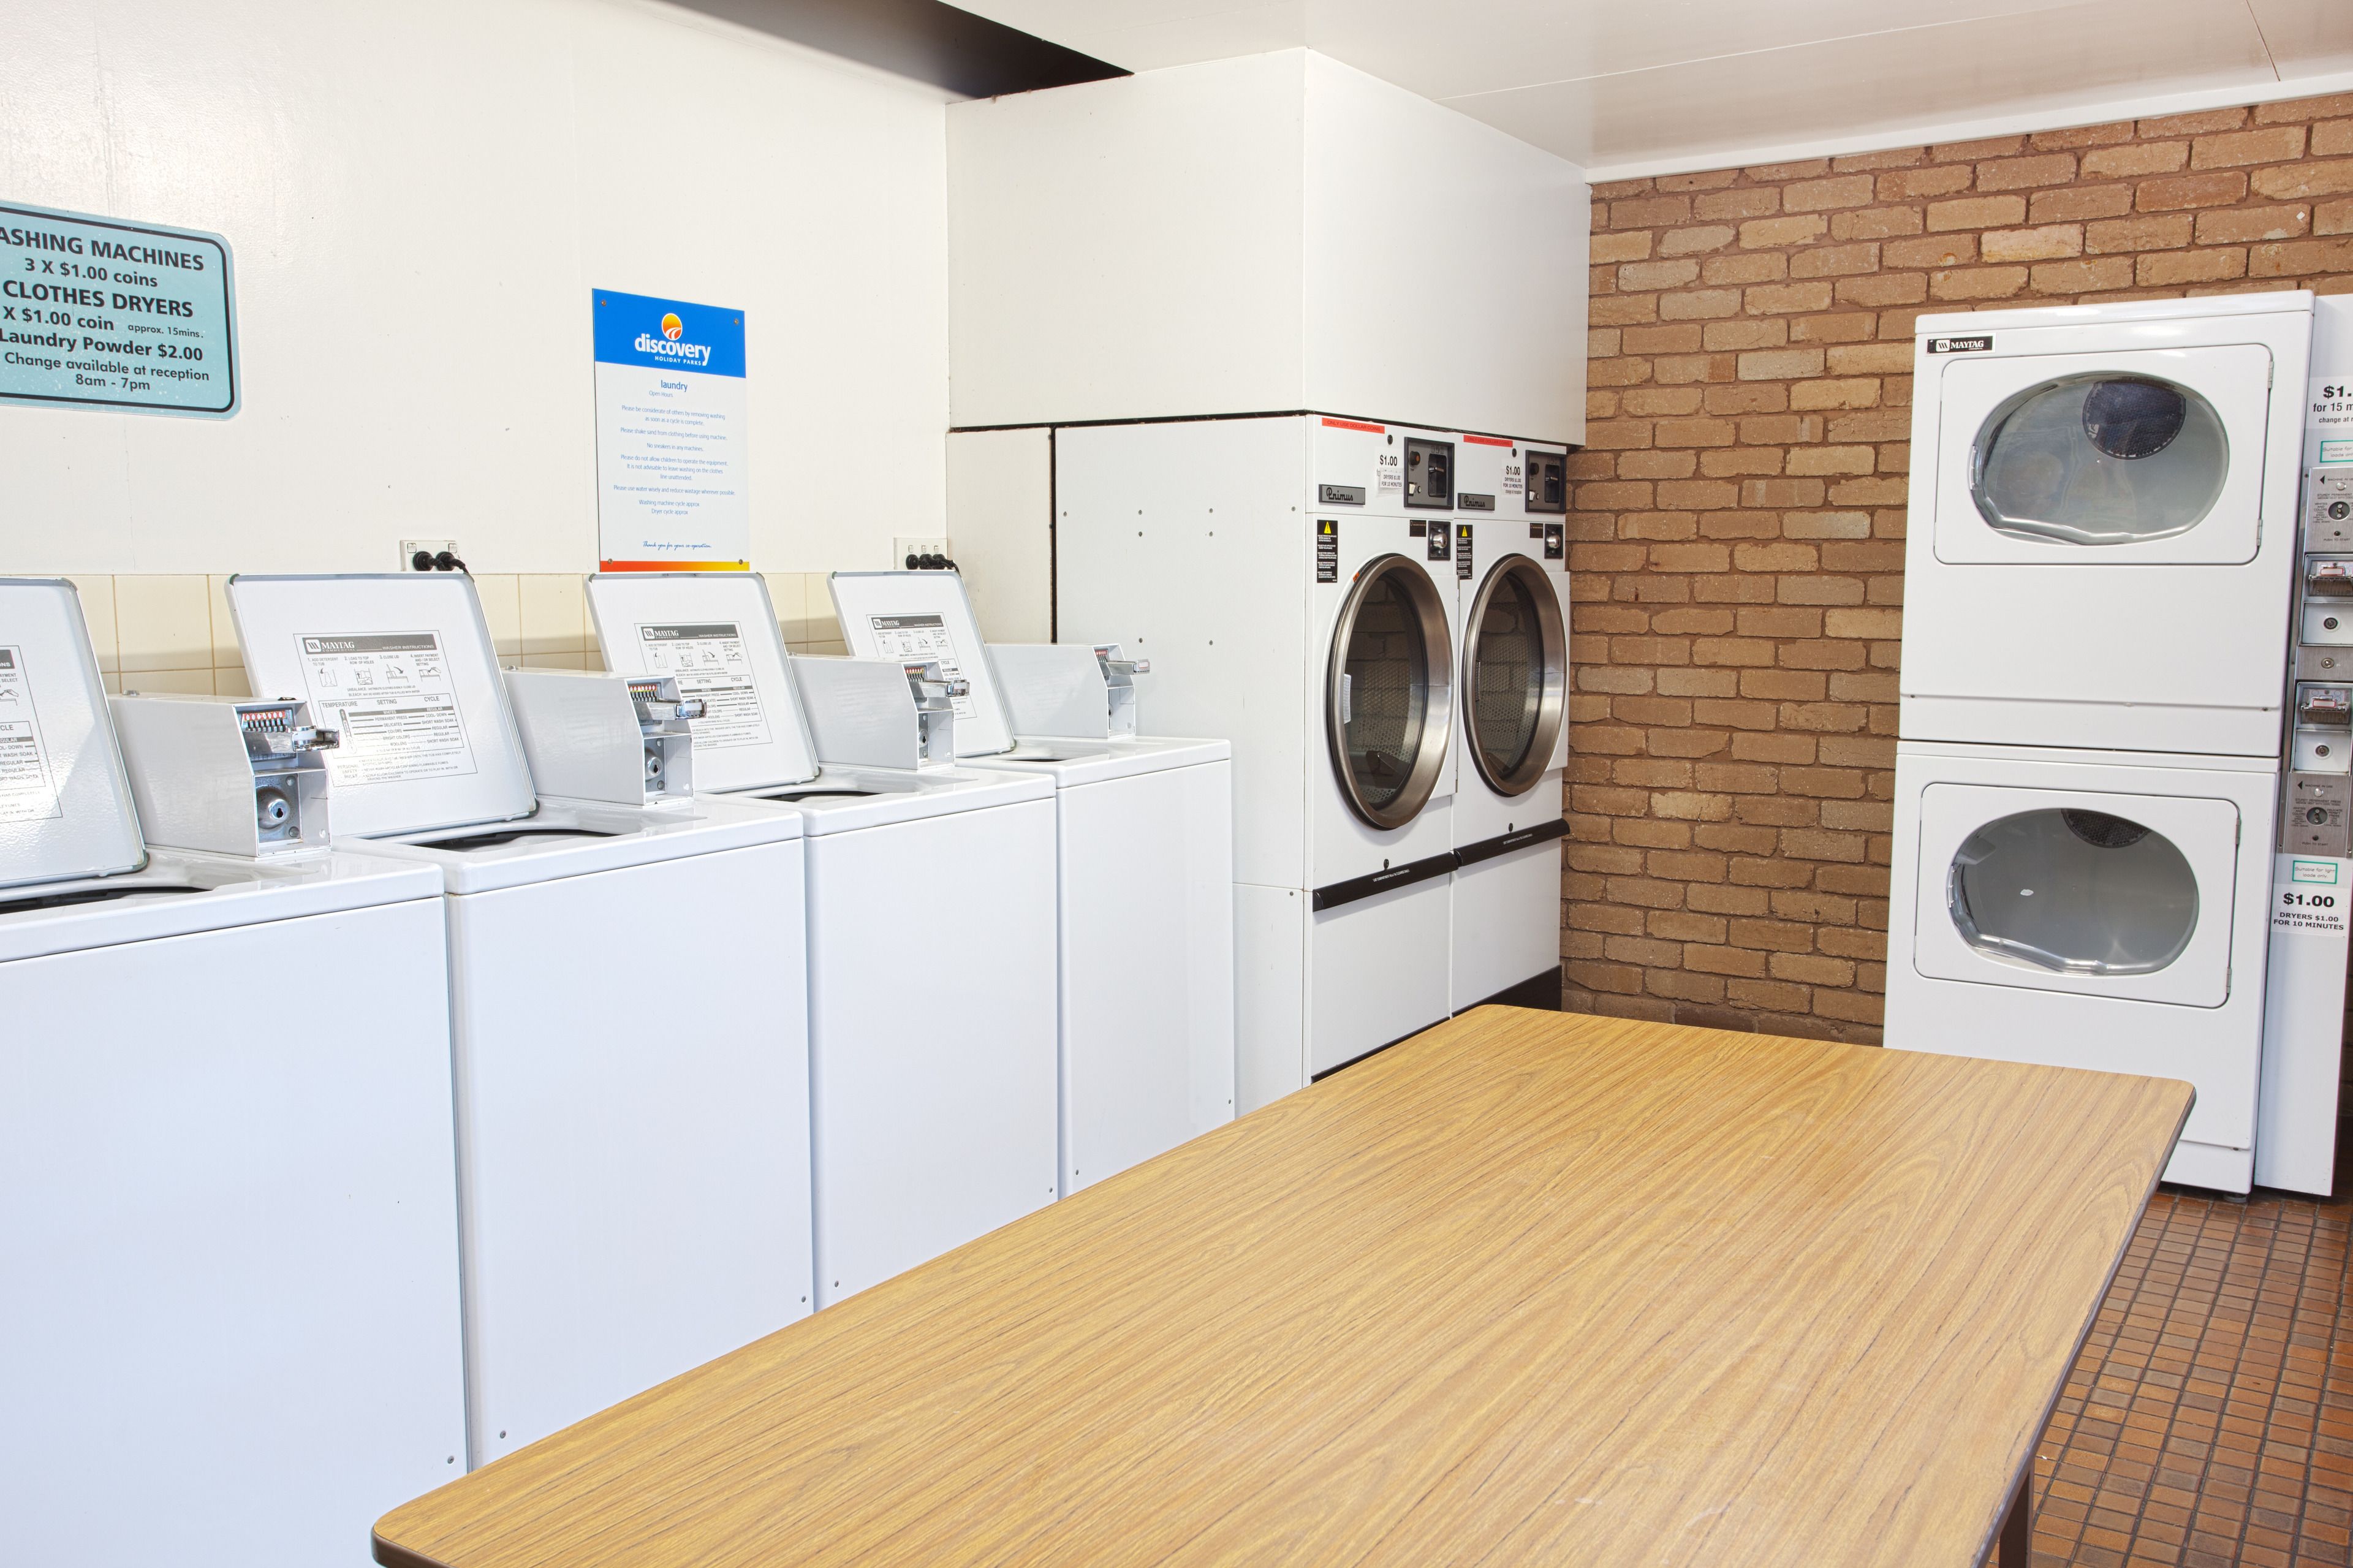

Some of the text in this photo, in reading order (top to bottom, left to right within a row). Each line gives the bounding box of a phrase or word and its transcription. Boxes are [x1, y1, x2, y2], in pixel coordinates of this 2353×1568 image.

[91, 240, 205, 271] MACHINES
[25, 258, 158, 287] 3 X $1.00 coins
[3, 280, 194, 318] CLOTHES DRYERS
[3, 306, 204, 338] X $1.00 coin approx. 15mins.
[0, 328, 203, 362] Laundry Powder $2.00
[635, 333, 711, 366] discovery
[1950, 340, 1984, 349] MAYTAG
[4, 352, 210, 381] Change available at reception
[75, 374, 151, 392] 8am 7pm
[661, 380, 688, 393] laundry
[2313, 403, 2327, 412] for
[2330, 402, 2343, 412] 15
[1379, 455, 1398, 466] $1.00
[1506, 465, 1520, 475] $1.00
[1326, 487, 1354, 501] Primus
[1464, 495, 1485, 507] Primus
[2283, 892, 2335, 908] $1.00
[2279, 912, 2313, 920] DRYERS
[2305, 922, 2344, 931] MINUTES
